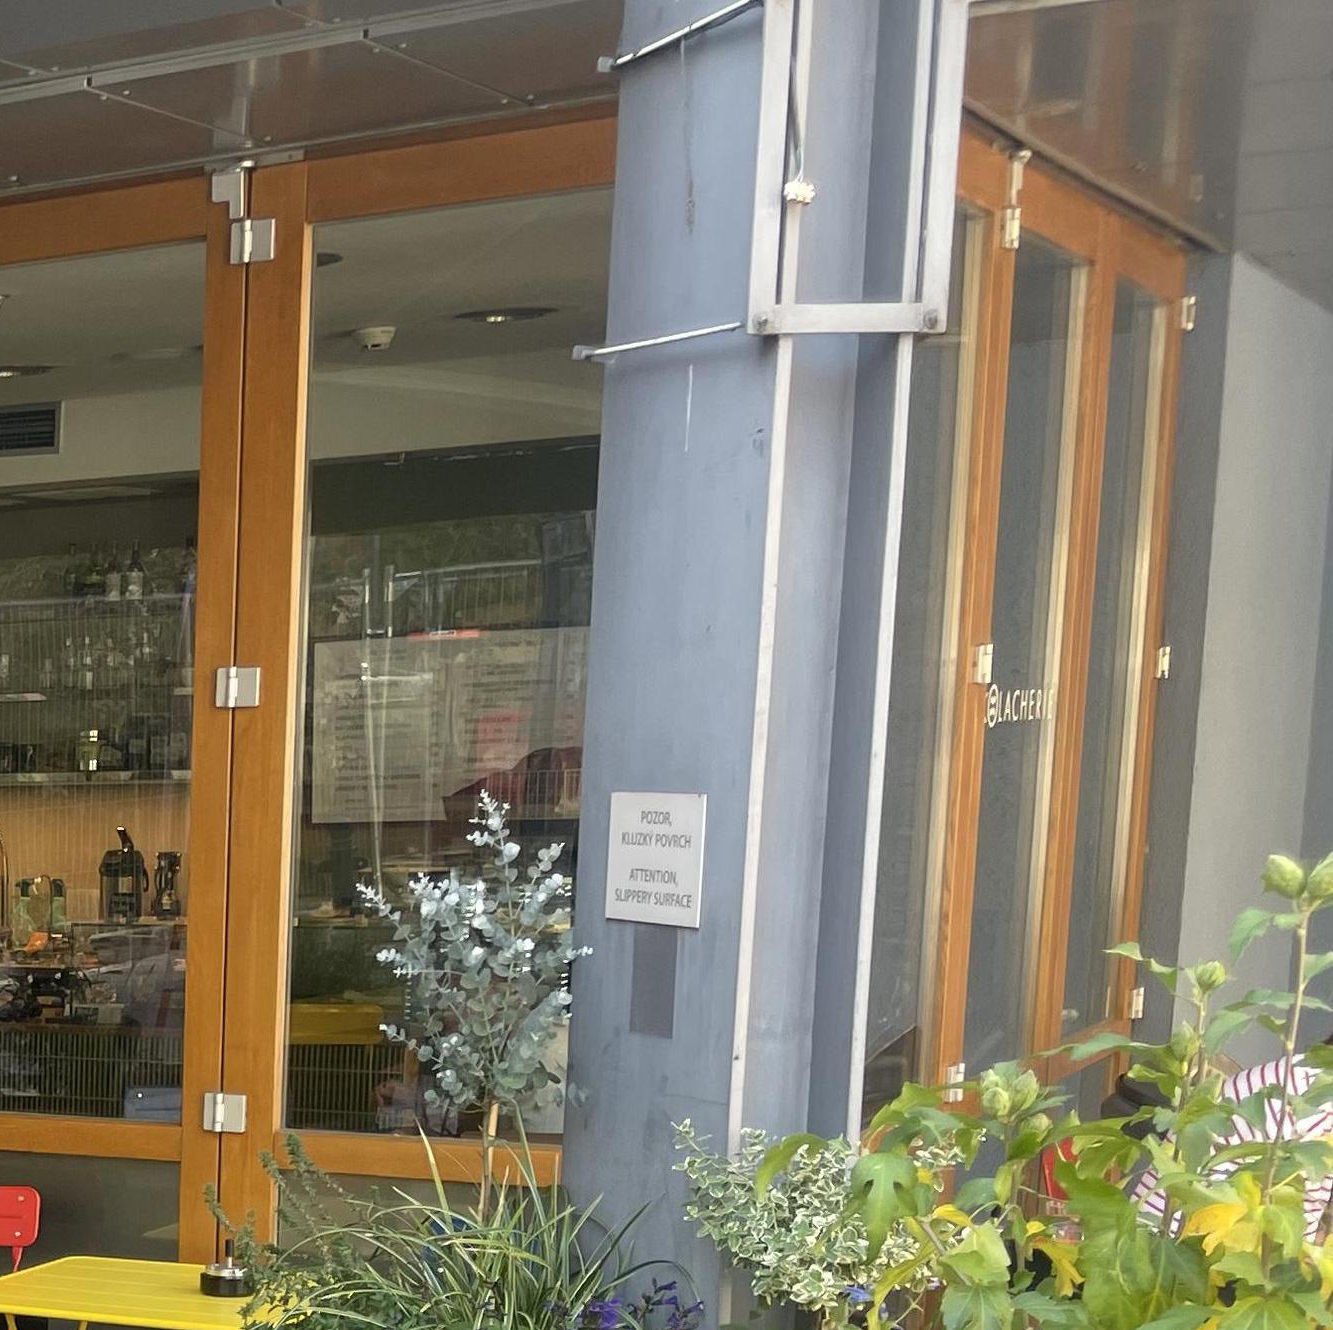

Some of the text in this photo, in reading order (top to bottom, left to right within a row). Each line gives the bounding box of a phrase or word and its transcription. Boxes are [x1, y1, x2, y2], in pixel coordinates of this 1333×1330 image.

[984, 684, 1054, 728] OLACHERIE
[641, 810, 672, 827] POZOR,
[621, 829, 692, 848] KLUZKÝ POVRCH
[629, 867, 678, 886] ATTENTION,
[615, 888, 692, 908] SLIPPERY SURFACE
